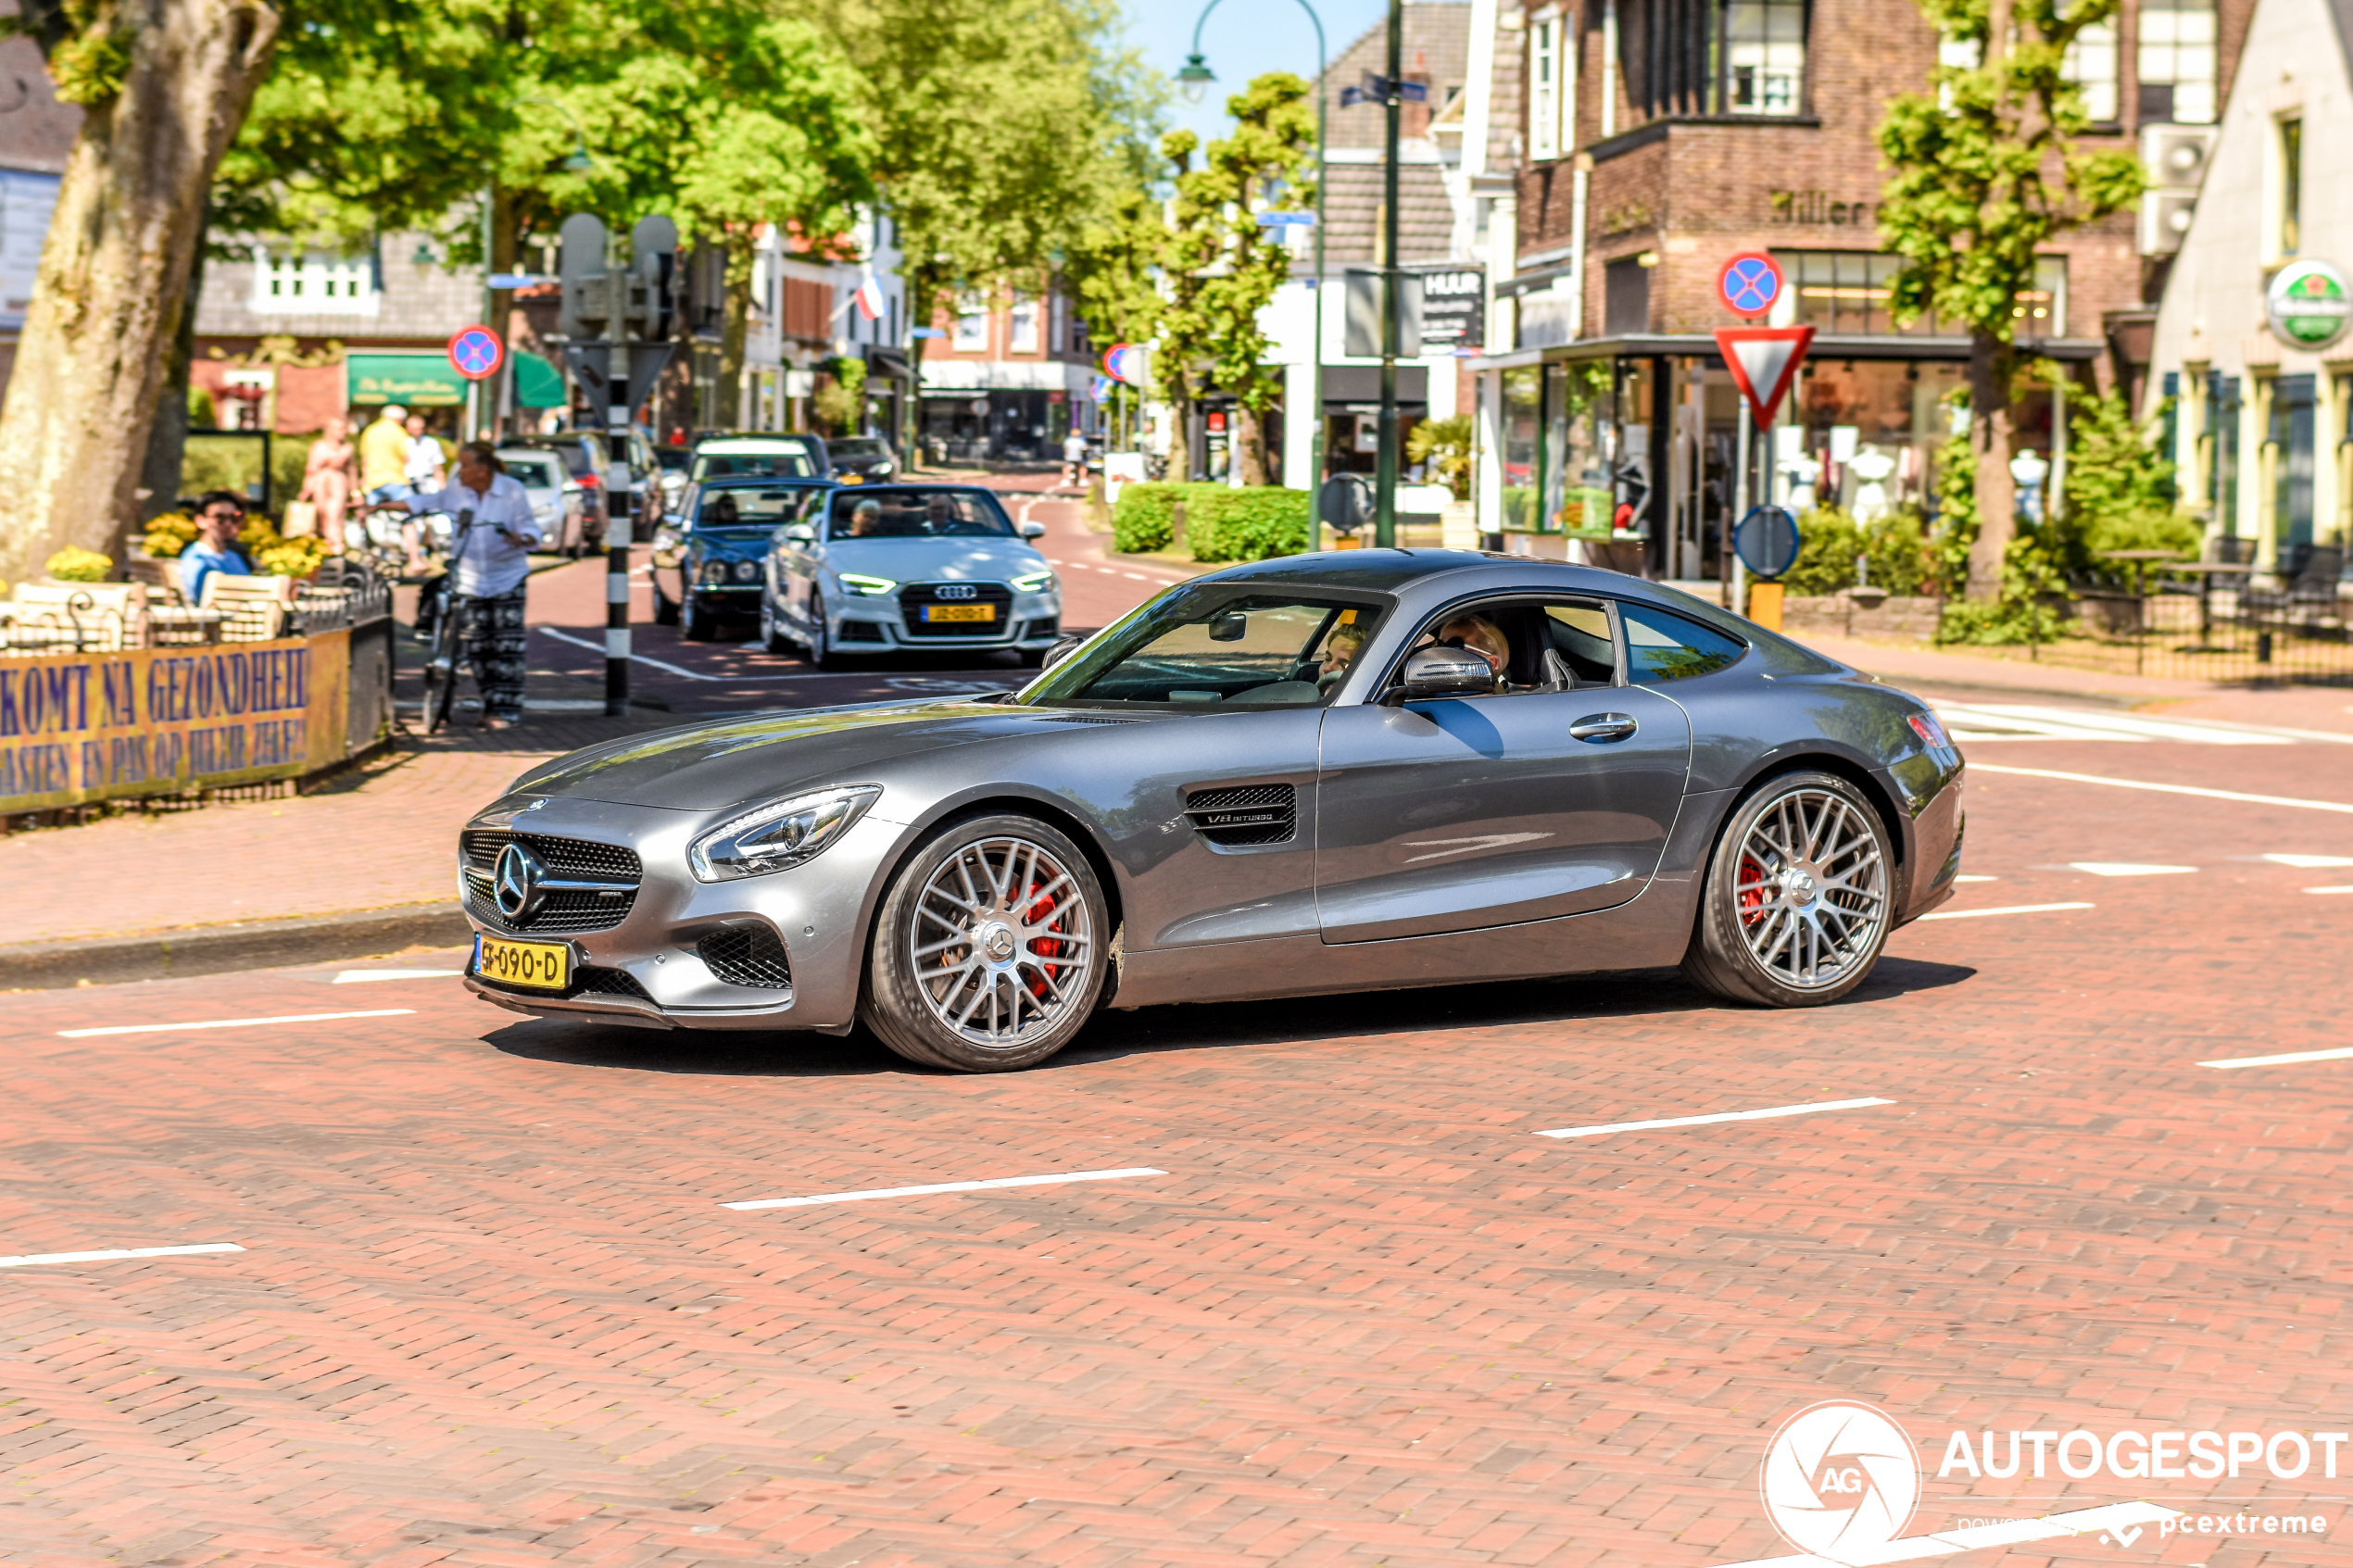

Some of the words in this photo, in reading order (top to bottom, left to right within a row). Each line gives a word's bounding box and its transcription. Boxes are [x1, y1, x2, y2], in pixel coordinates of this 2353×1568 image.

[0, 665, 91, 736] KOMT
[102, 660, 136, 730] NA
[82, 738, 104, 790] EN
[109, 734, 148, 785] PAS
[155, 732, 182, 780] OP
[482, 942, 557, 981] GF-090-D
